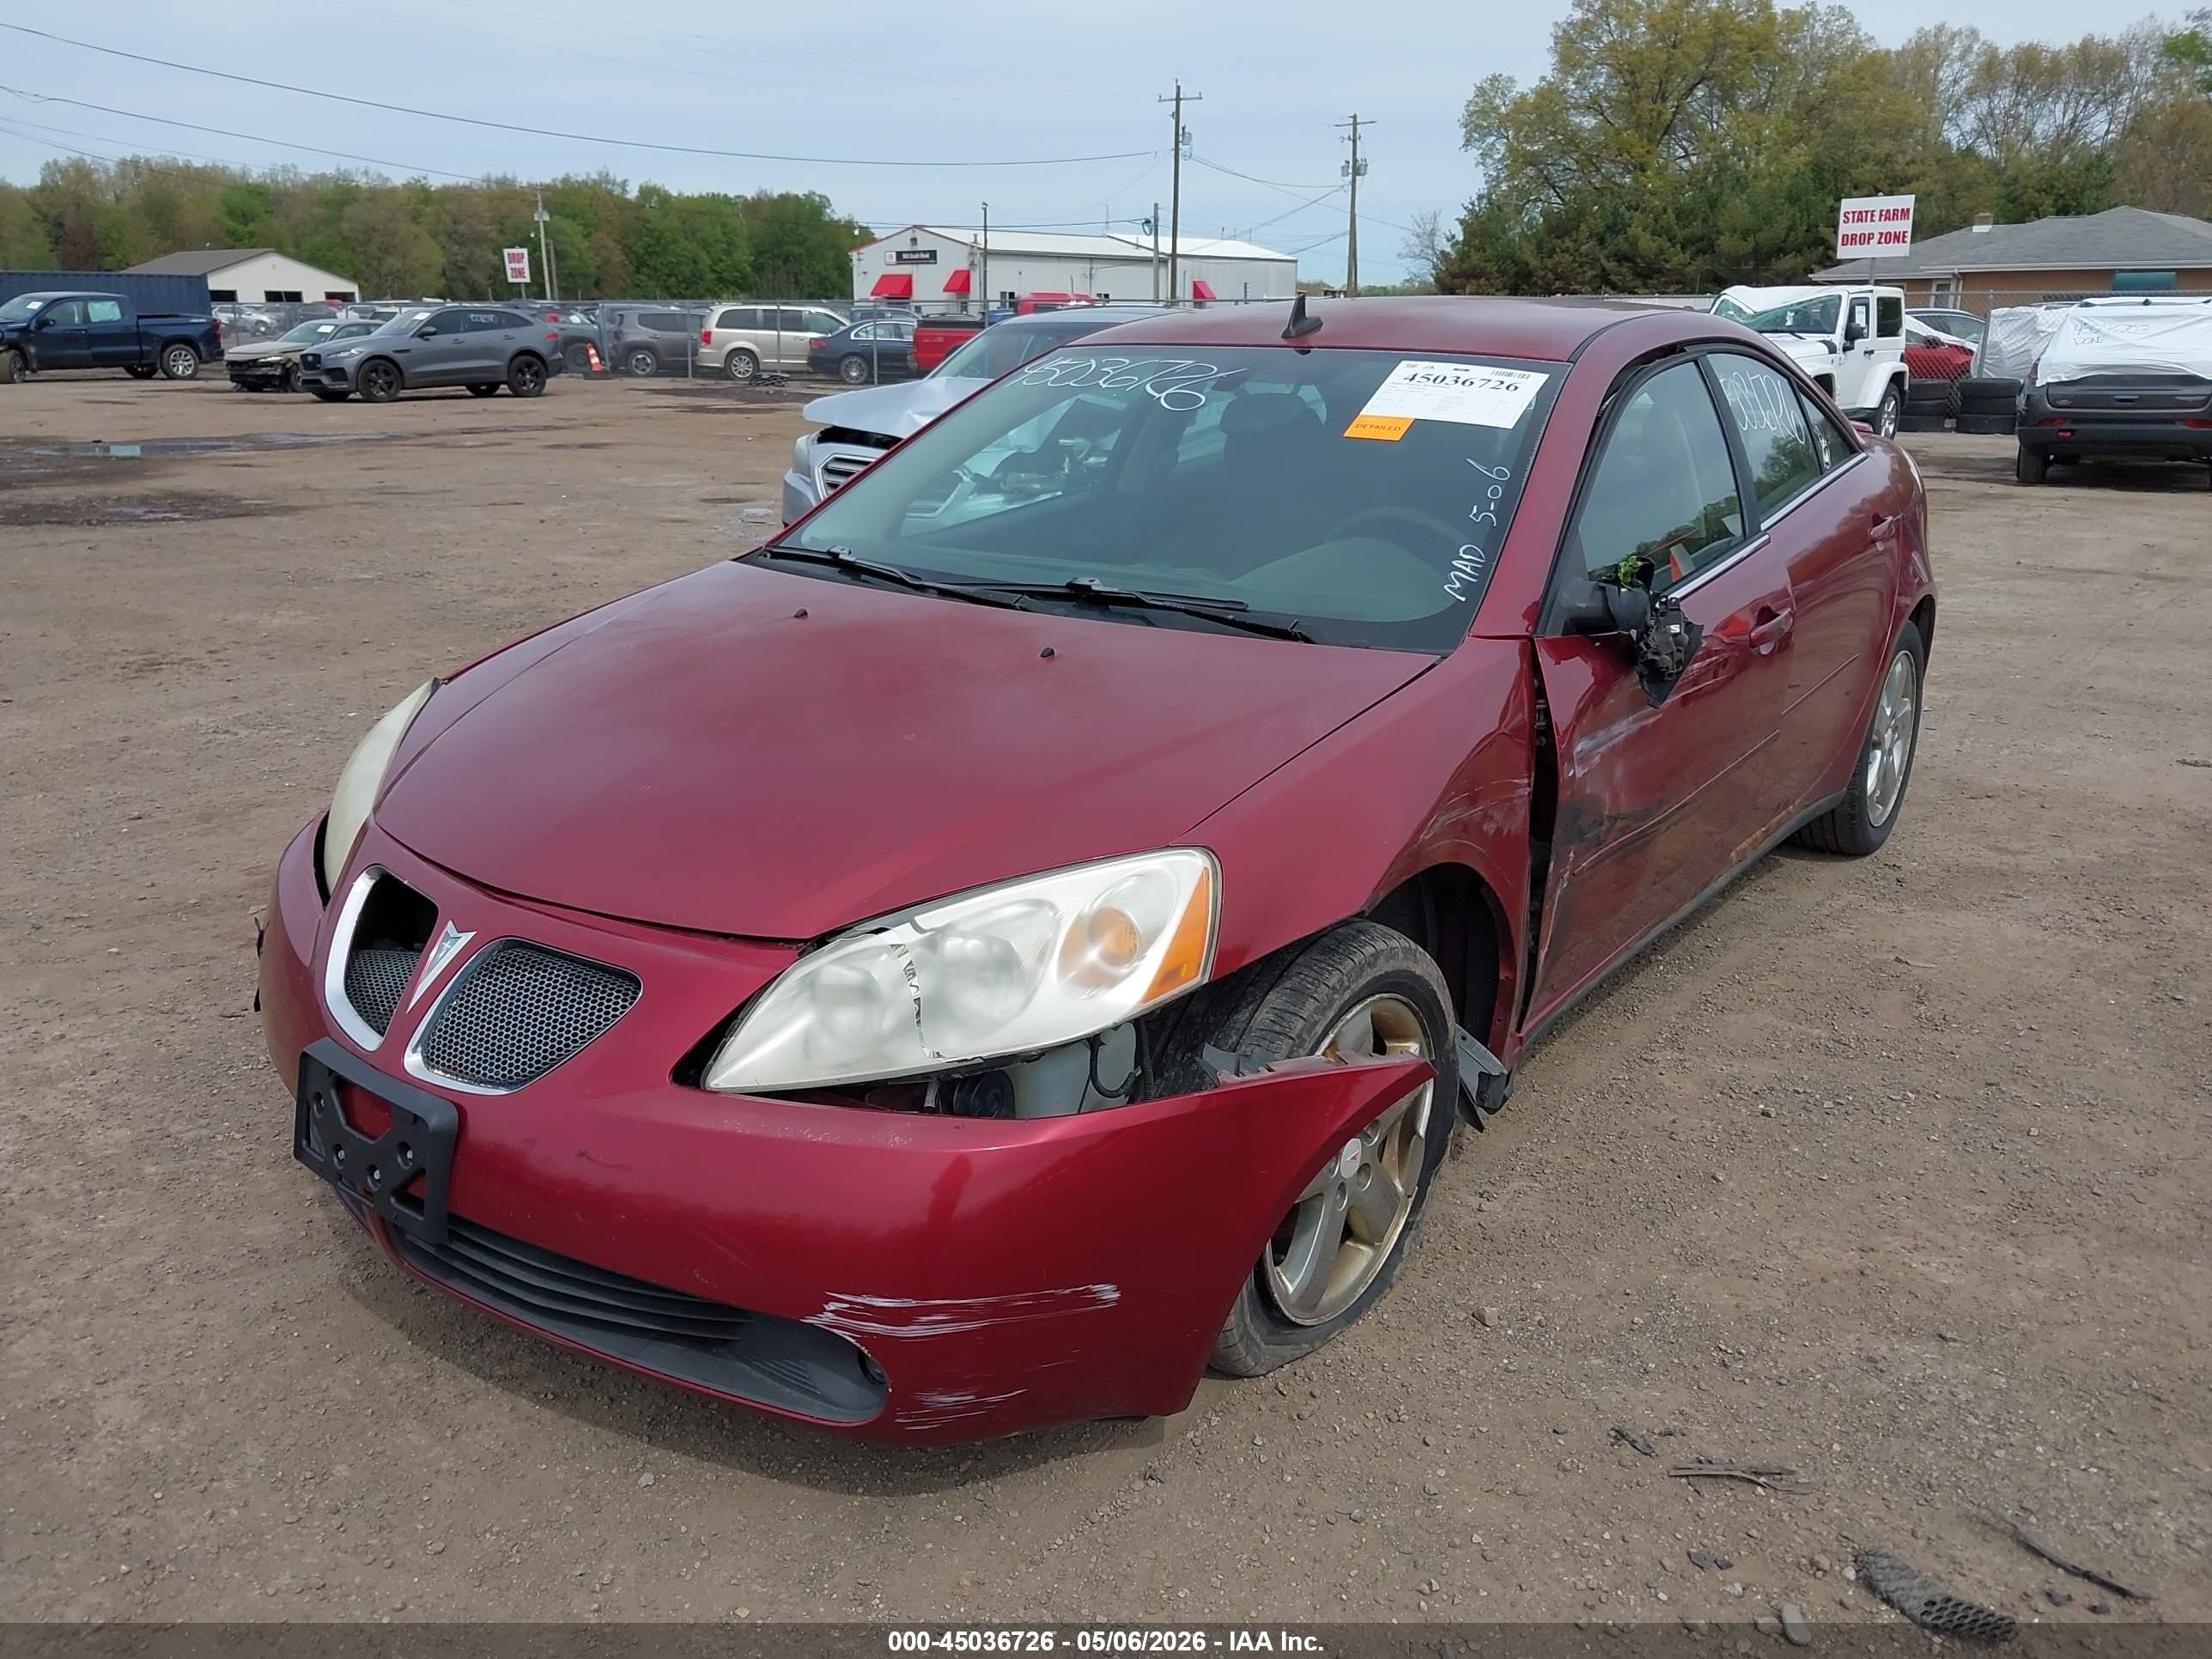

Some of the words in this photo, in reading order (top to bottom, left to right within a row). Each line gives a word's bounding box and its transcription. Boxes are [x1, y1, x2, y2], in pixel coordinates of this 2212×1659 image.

[1843, 210, 1876, 224] STATE
[1878, 207, 1911, 222] FARM
[1841, 232, 1875, 246] DROP
[1877, 230, 1908, 245] ZONE
[507, 252, 525, 264] DROP
[510, 267, 527, 279] ZONE
[1402, 372, 1520, 392] 45036726
[1354, 422, 1401, 432] DETAILED
[1443, 544, 1486, 602] MAD
[1465, 458, 1511, 527] 5-06
